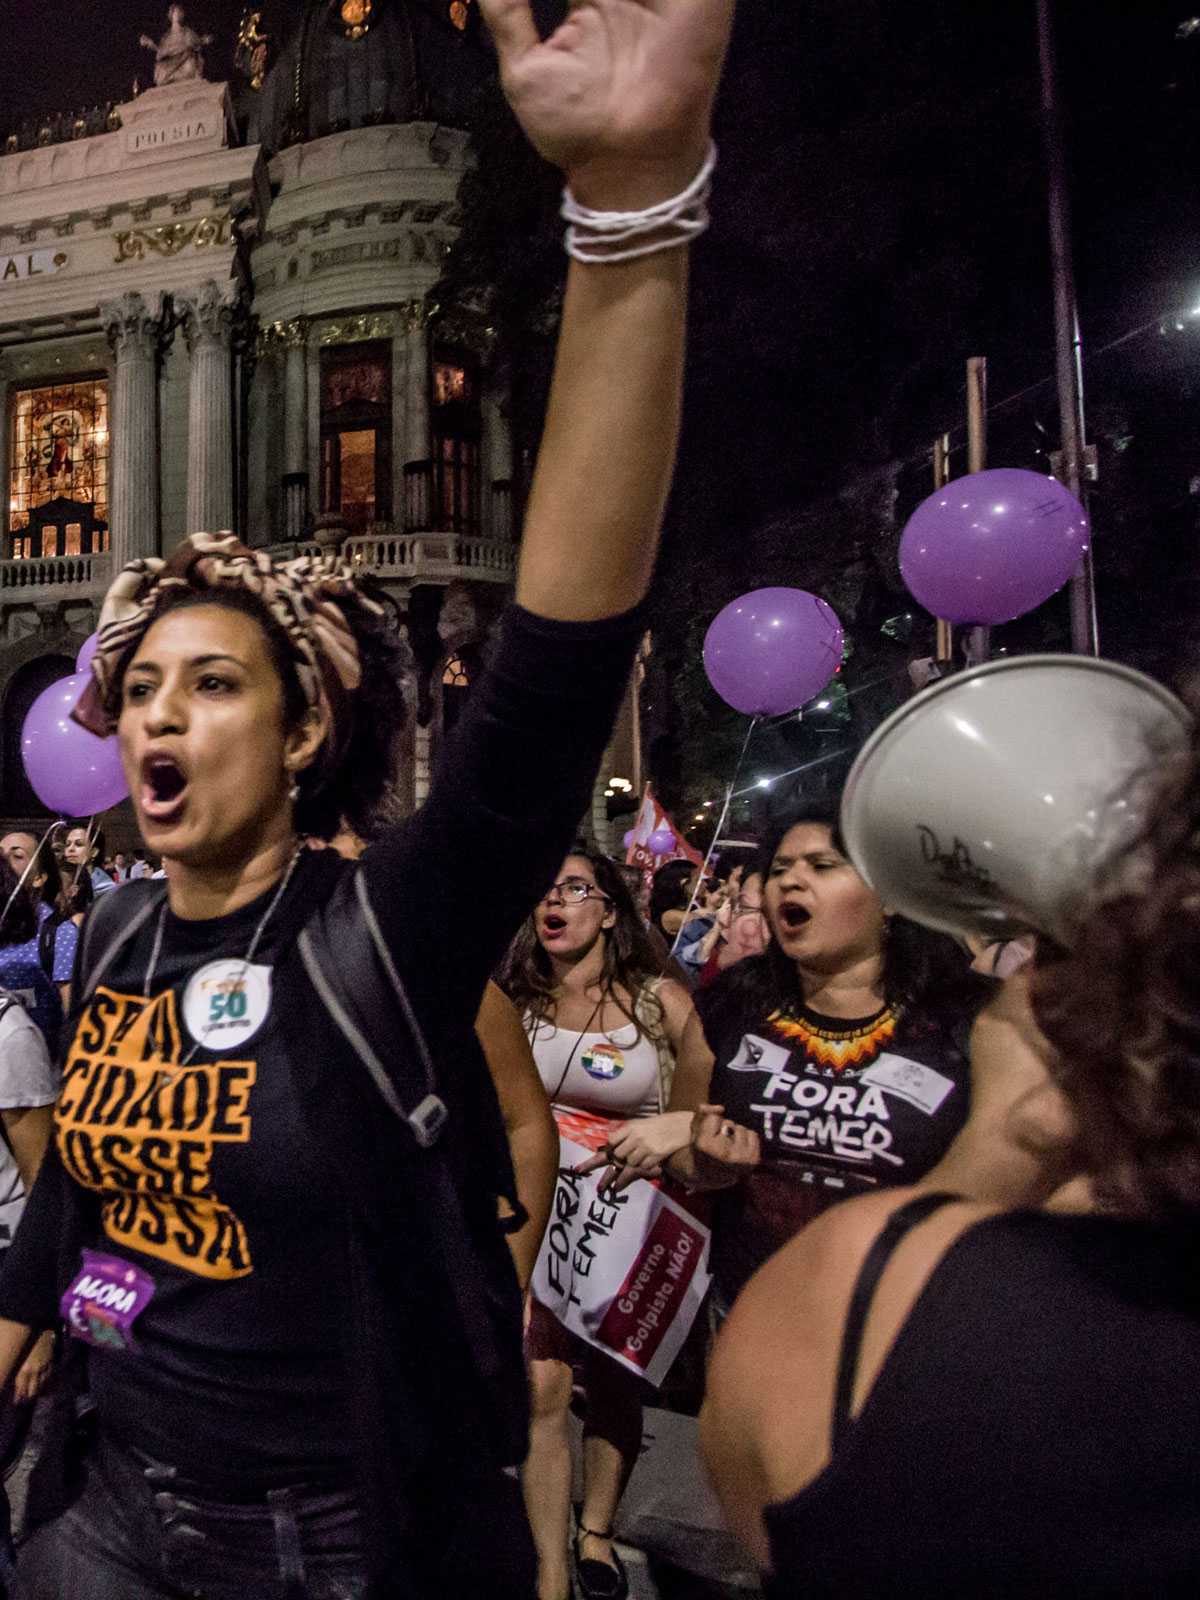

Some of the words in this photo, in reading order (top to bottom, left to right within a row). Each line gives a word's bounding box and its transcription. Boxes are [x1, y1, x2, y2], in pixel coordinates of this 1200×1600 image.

[209, 992, 247, 1022] 50
[58, 1058, 253, 1137] CIDADE
[763, 1072, 890, 1120] FORA
[749, 1103, 905, 1167] TEMER
[547, 1165, 592, 1298] FORA
[568, 1181, 629, 1307] TEMER
[665, 1231, 694, 1281] NÃO!
[72, 1275, 137, 1314] AGORA
[617, 1243, 665, 1315] Governo
